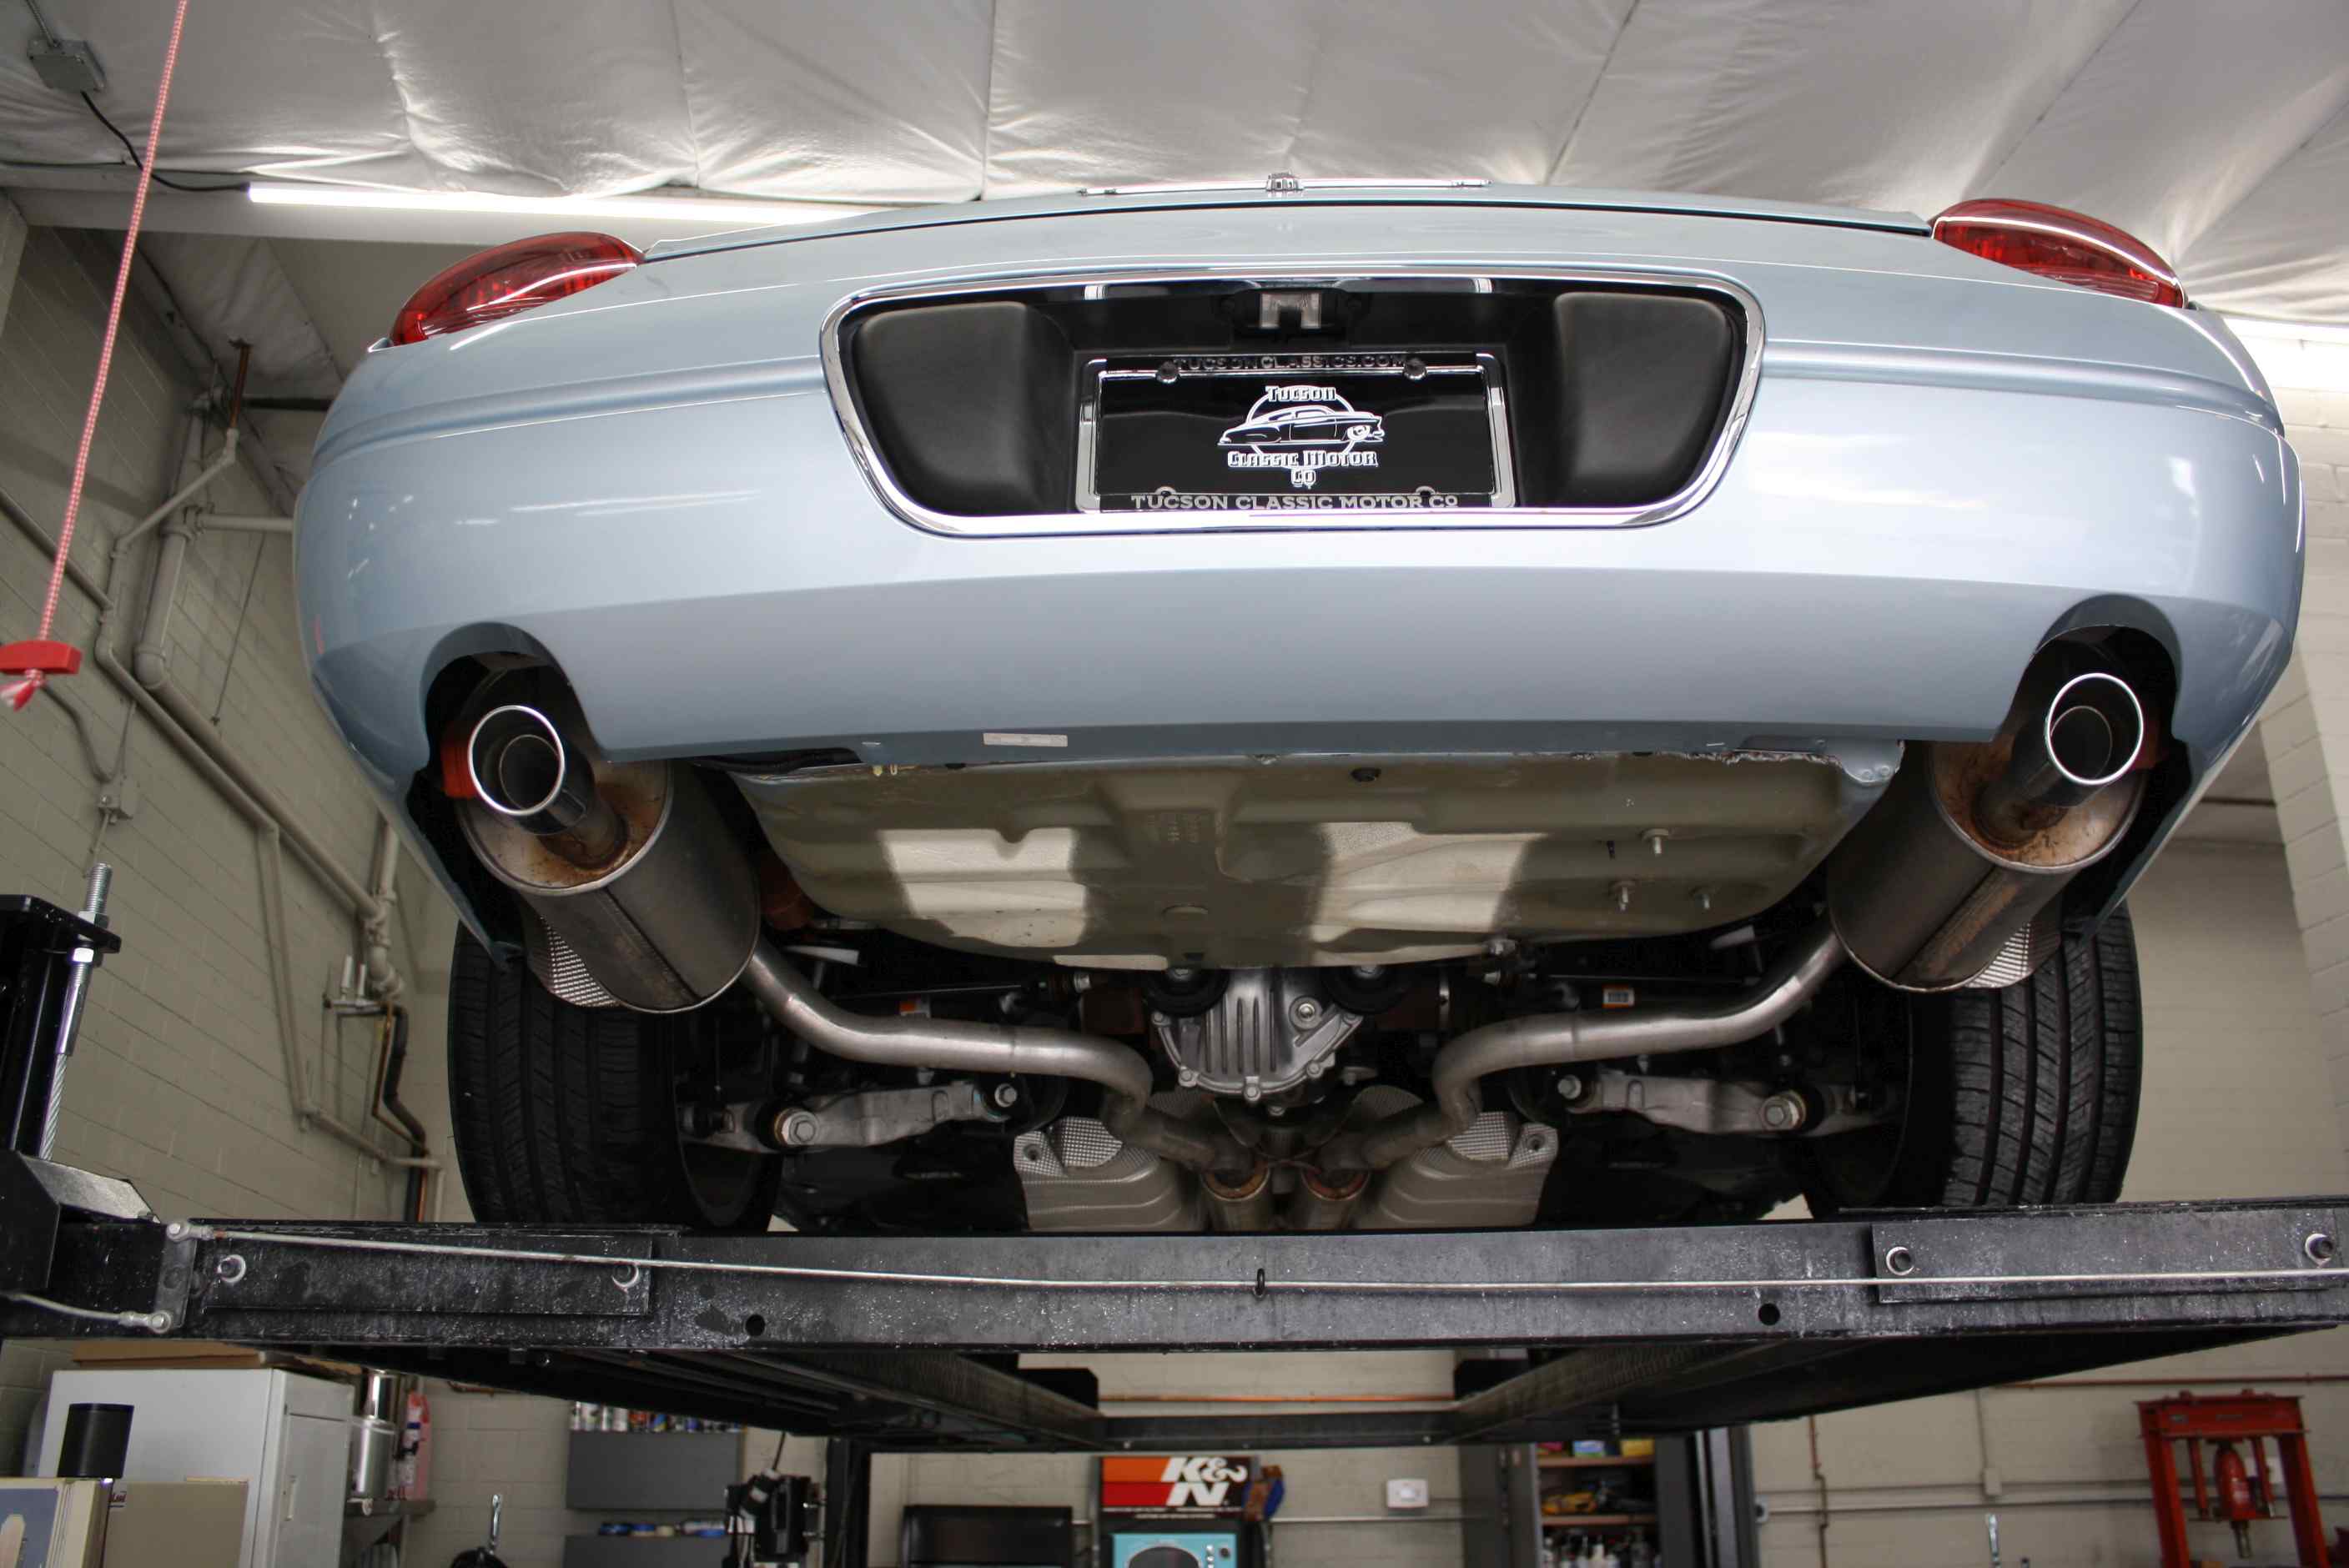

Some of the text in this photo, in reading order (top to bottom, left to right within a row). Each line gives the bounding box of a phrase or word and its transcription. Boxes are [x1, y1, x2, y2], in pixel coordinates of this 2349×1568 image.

[1131, 495, 1227, 510] TUCSON
[1235, 495, 1333, 510] CLASSIC
[1339, 495, 1421, 510] MOTOR
